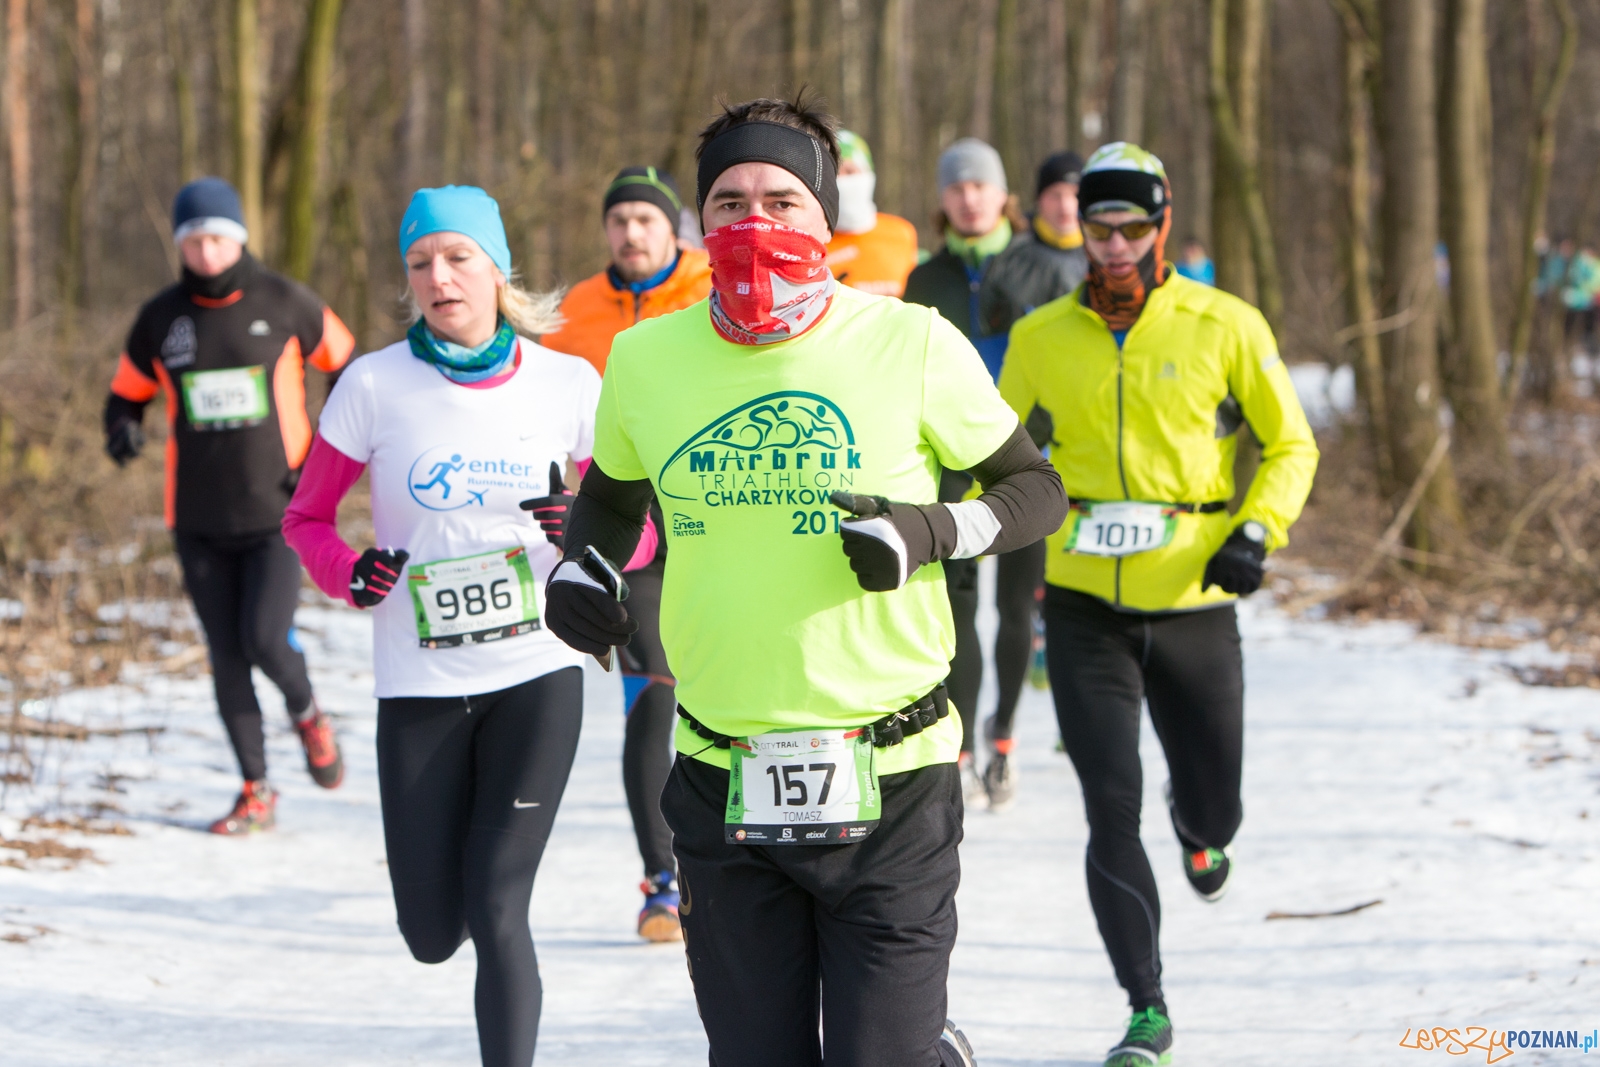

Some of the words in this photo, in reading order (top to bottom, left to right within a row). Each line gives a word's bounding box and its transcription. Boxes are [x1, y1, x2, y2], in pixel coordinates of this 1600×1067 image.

[731, 222, 772, 232] DECATHLON
[469, 458, 533, 477] enter
[467, 477, 514, 488] Runners
[518, 481, 542, 490] Club
[698, 472, 854, 490] TRIATHLON
[705, 489, 850, 507] CHARZYKOW
[792, 510, 842, 535] 201
[673, 529, 706, 537] TRITOUR
[1095, 523, 1152, 547] 1011
[436, 578, 511, 620] 986
[766, 763, 837, 806] 157
[783, 811, 822, 822] TOMASZ
